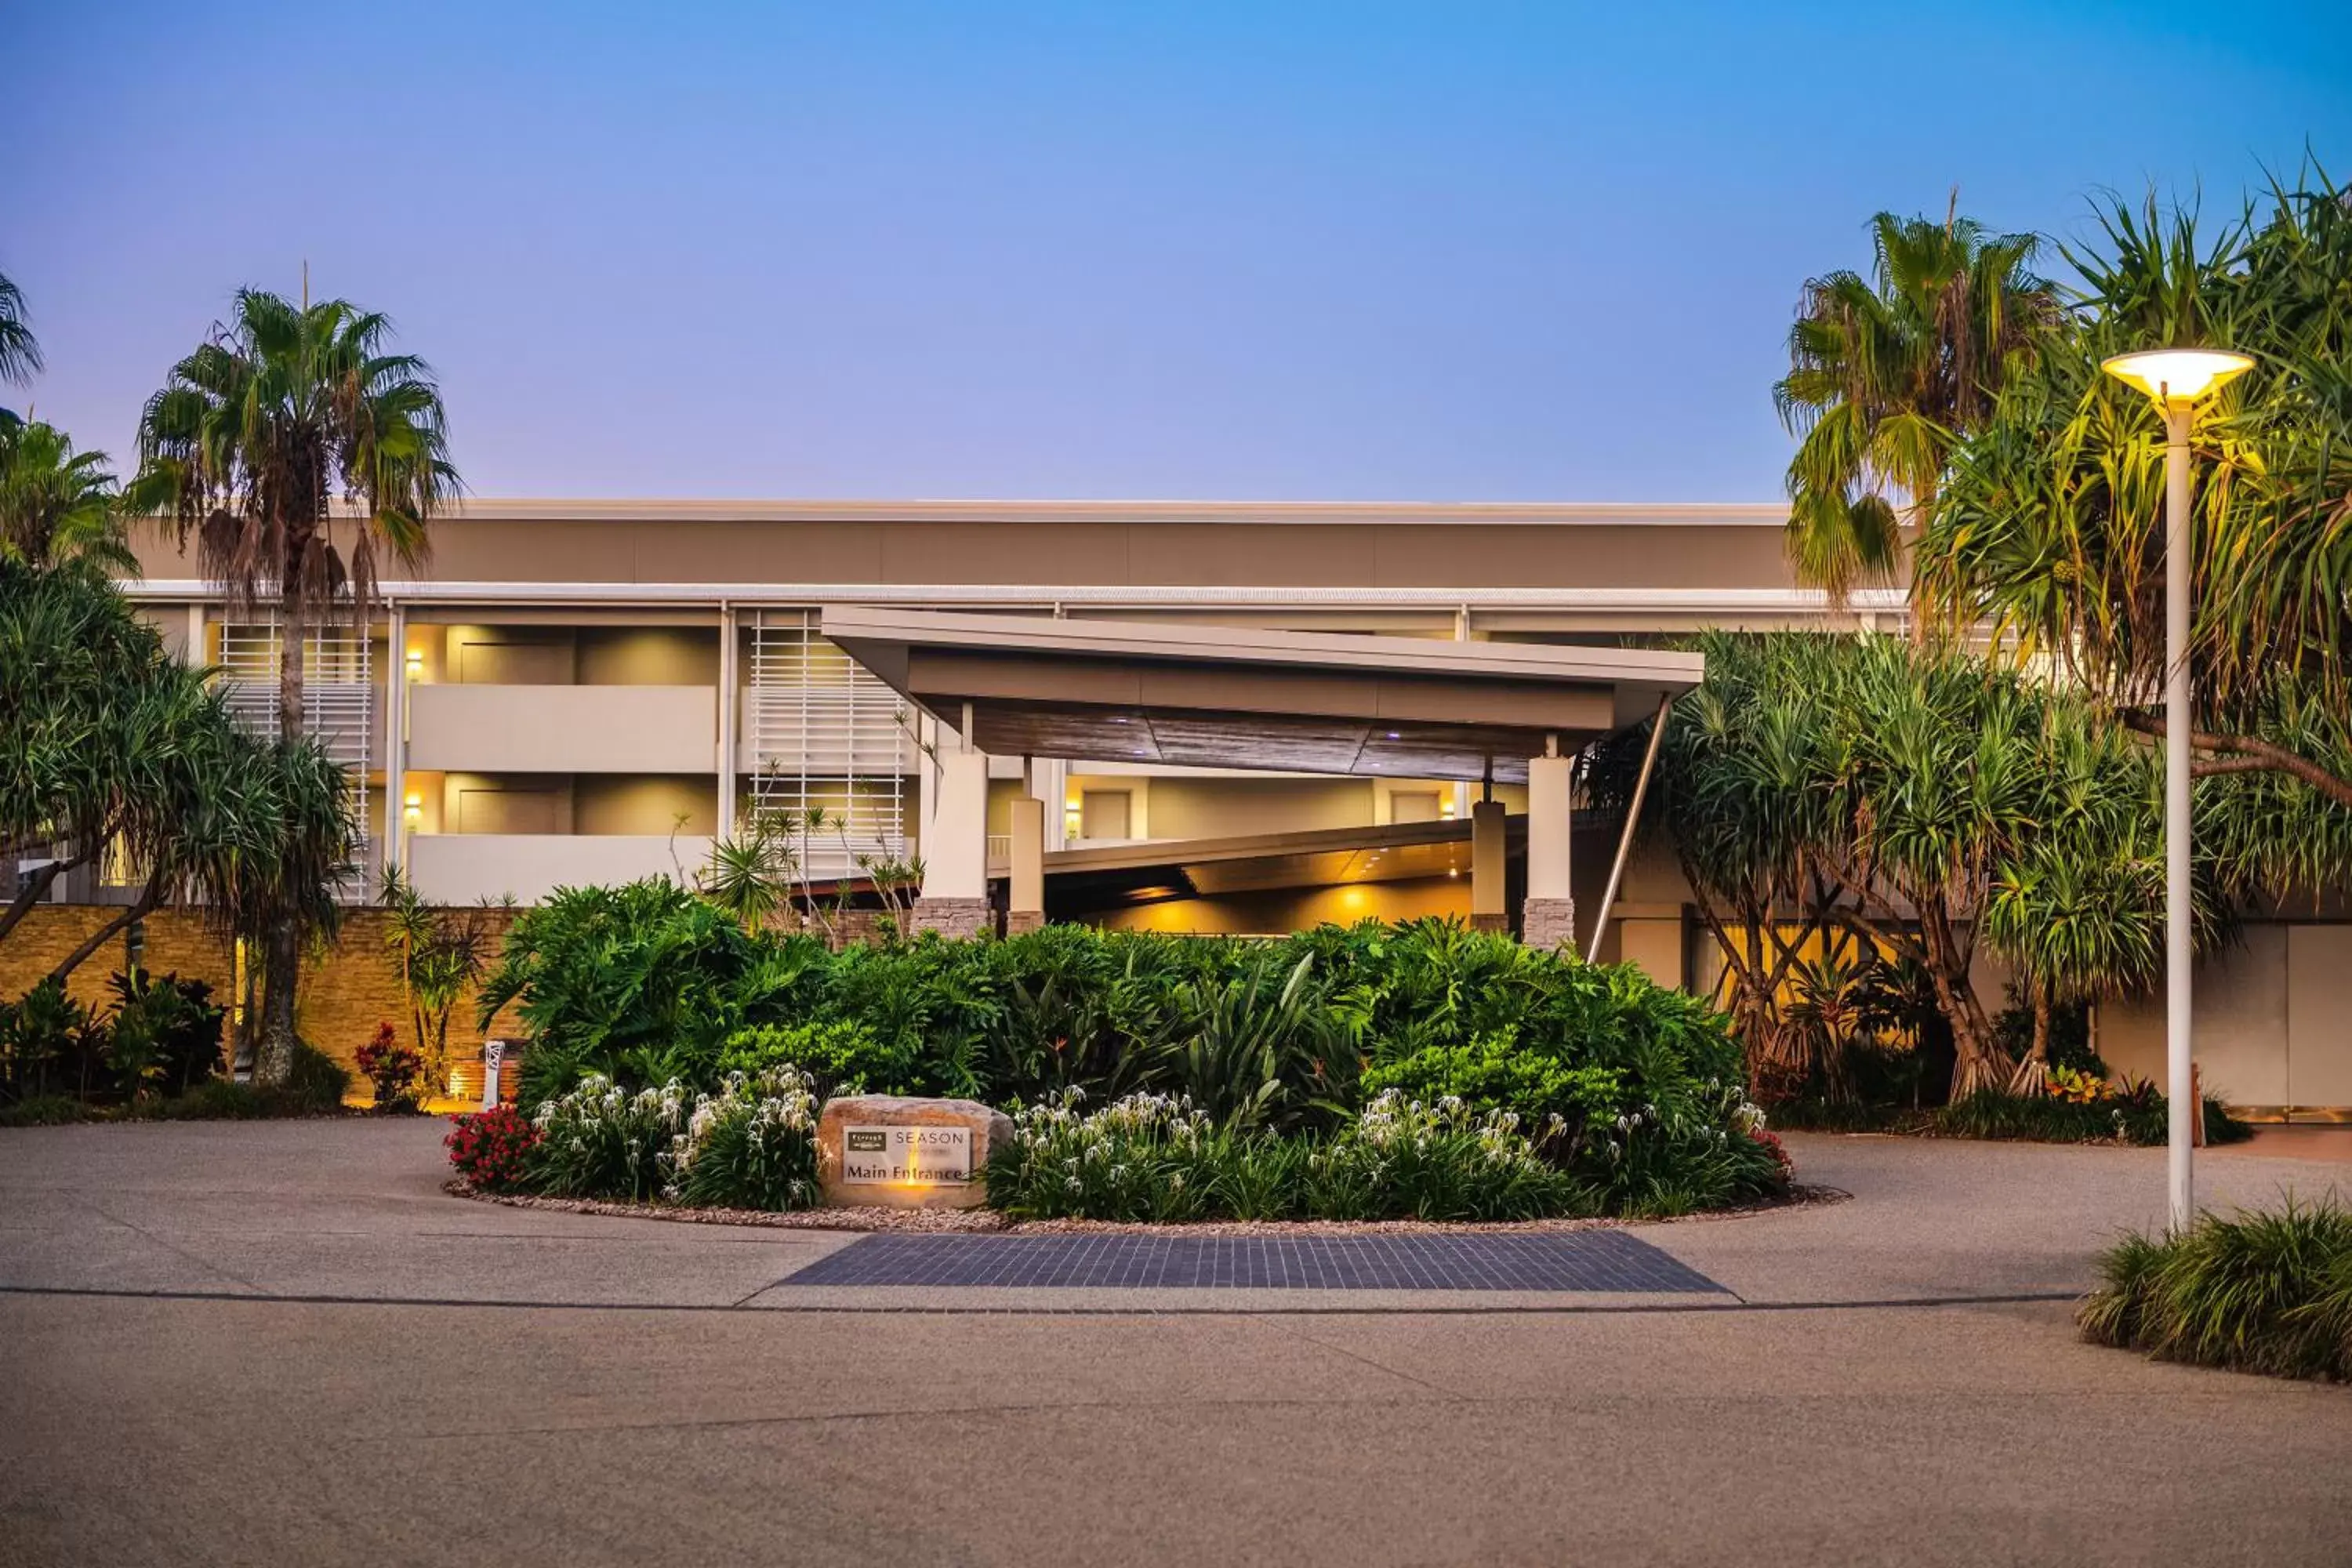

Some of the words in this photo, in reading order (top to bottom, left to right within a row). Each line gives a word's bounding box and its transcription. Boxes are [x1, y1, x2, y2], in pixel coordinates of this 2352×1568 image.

[896, 1132, 964, 1144] SEASON
[848, 1164, 887, 1178] Main
[893, 1167, 962, 1180] Entrance
